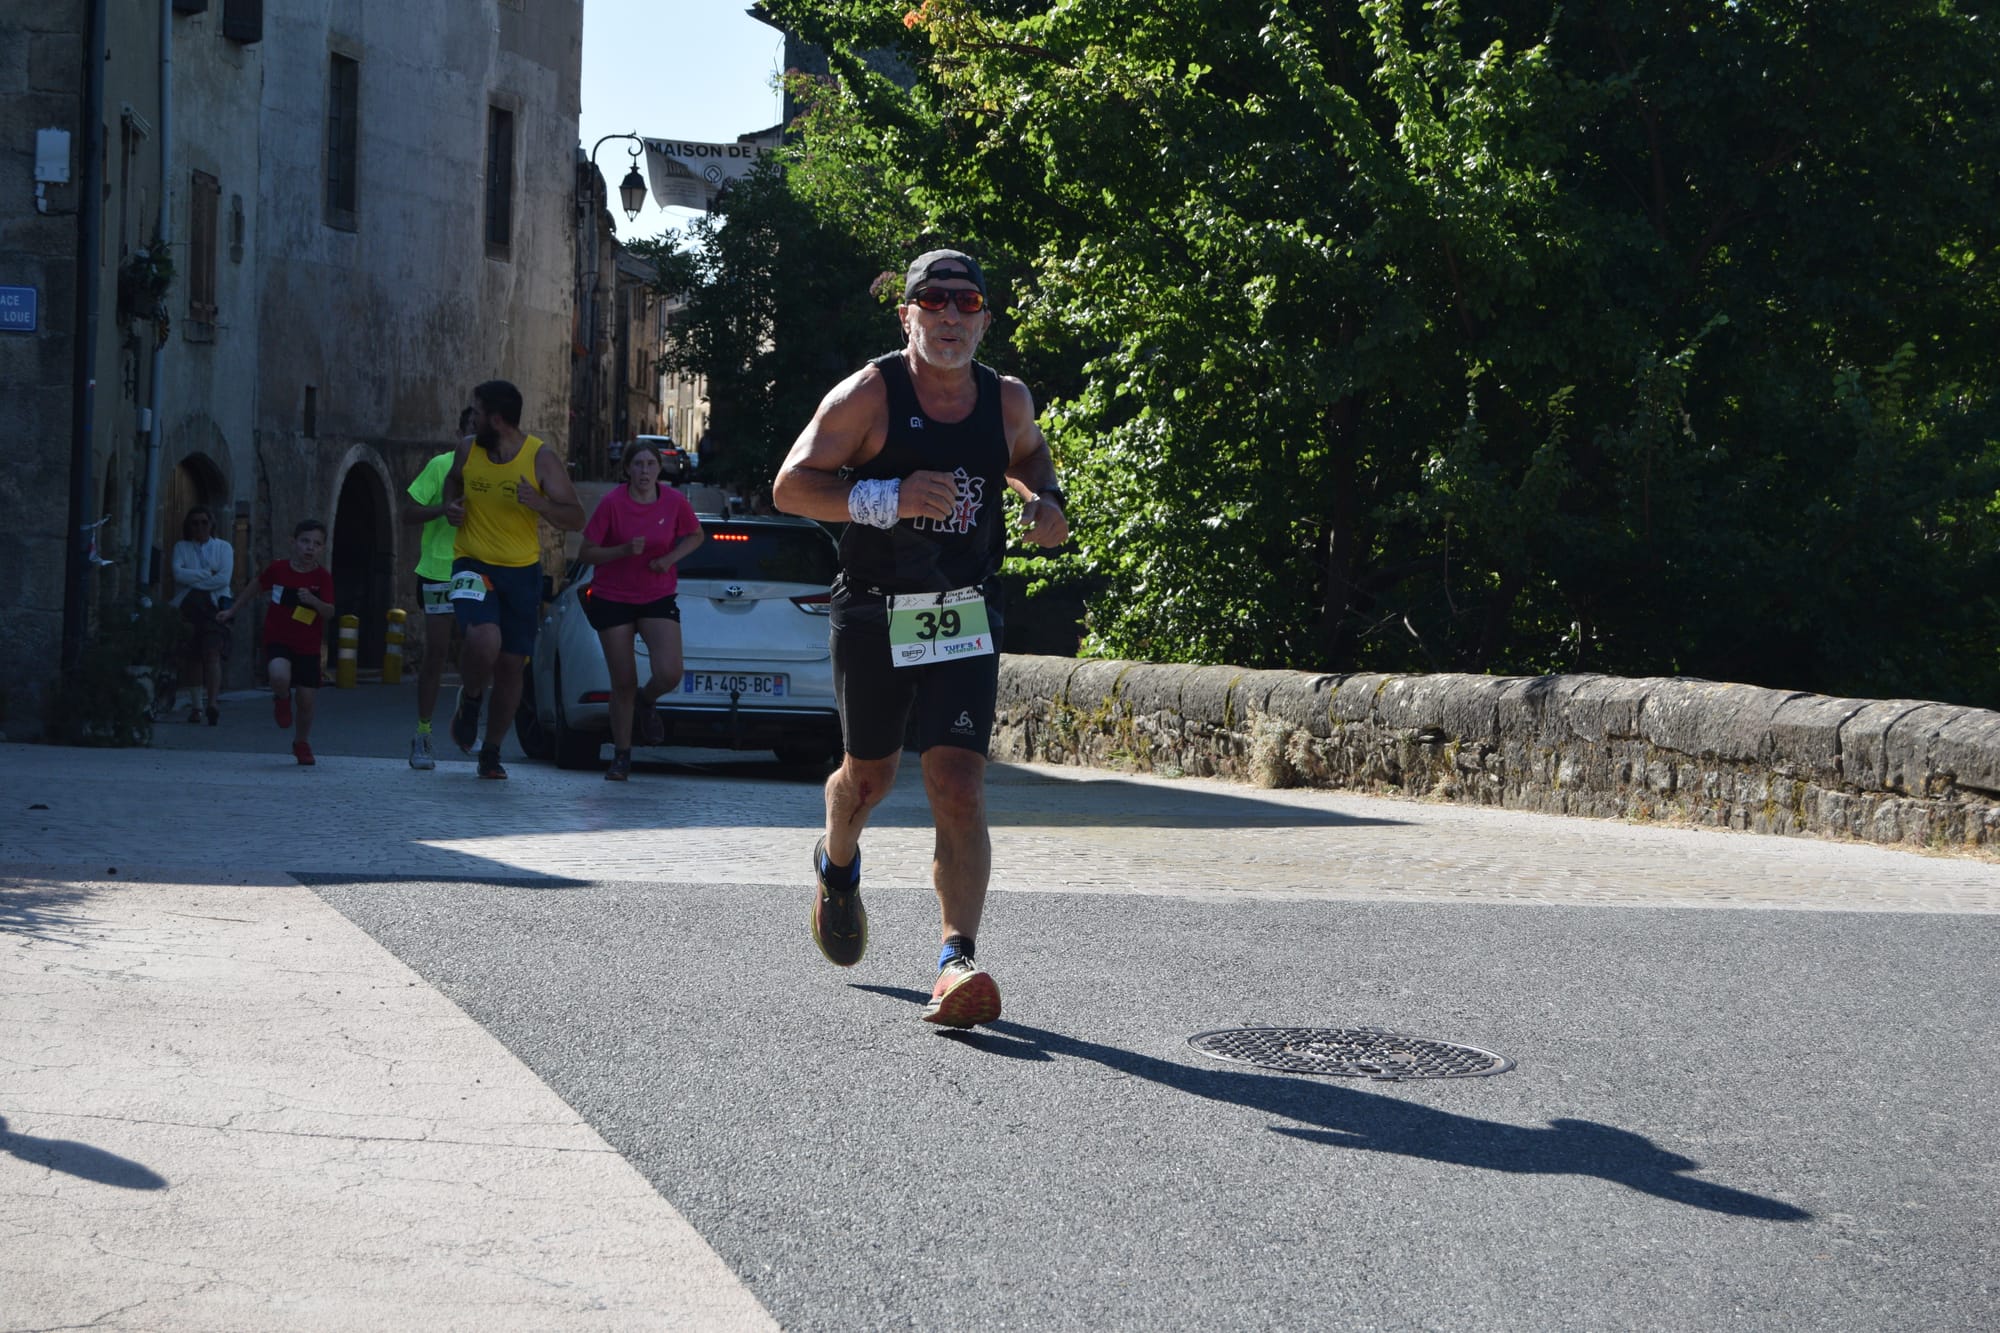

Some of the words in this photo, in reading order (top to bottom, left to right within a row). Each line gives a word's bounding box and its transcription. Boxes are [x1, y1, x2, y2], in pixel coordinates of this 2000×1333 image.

[648, 142, 722, 158] MAISON
[728, 146, 751, 158] DE
[0, 295, 20, 306] ACE
[4, 312, 31, 322] LOUE
[915, 610, 961, 640] 39
[695, 675, 772, 693] FA-405-BC
